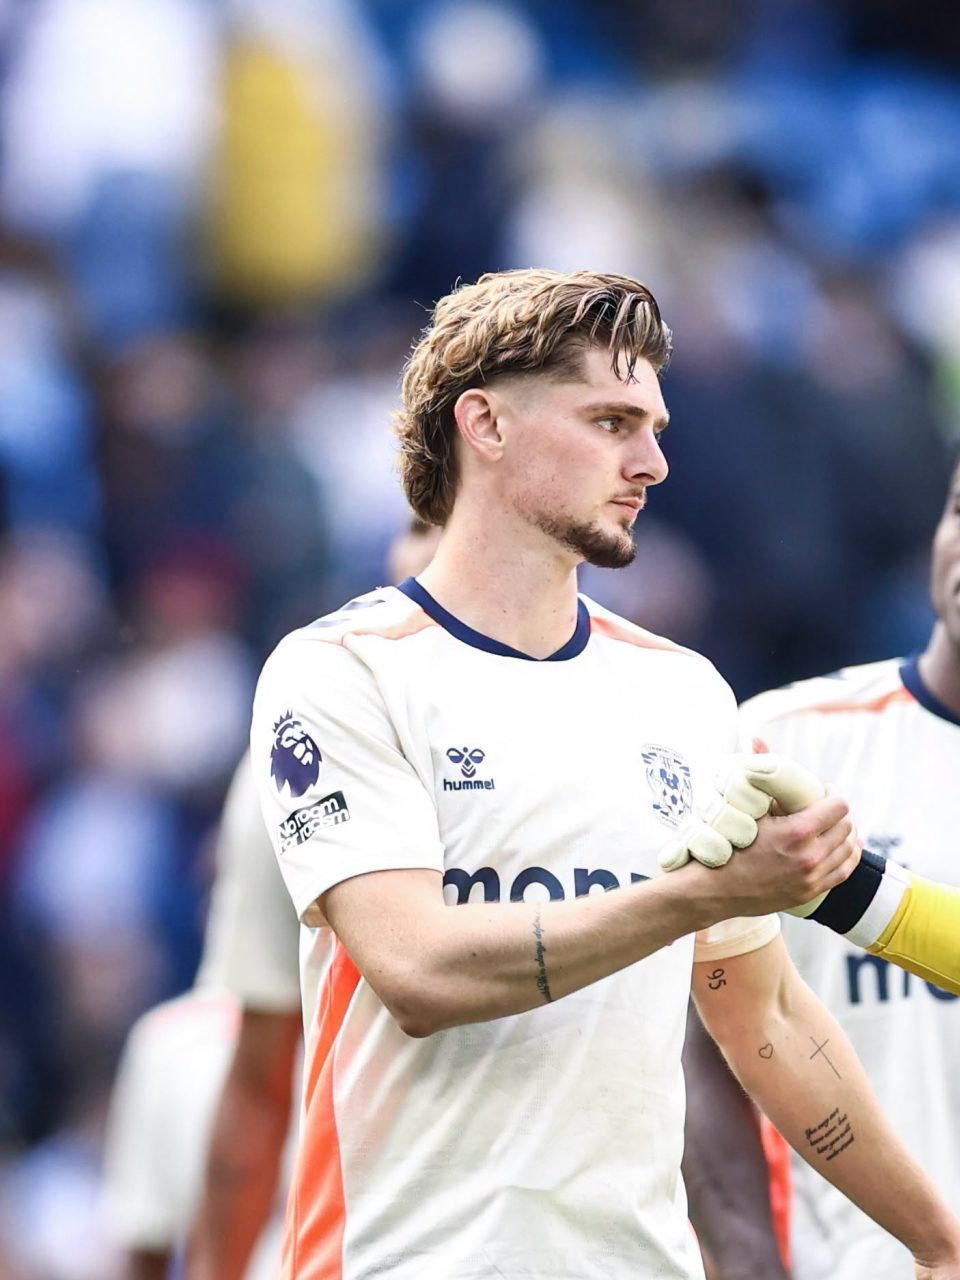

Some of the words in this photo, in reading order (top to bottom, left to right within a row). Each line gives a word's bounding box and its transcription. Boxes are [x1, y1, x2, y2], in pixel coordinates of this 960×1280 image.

[443, 778, 495, 791] hummel
[295, 798, 340, 828] room
[706, 968, 727, 990] 95
